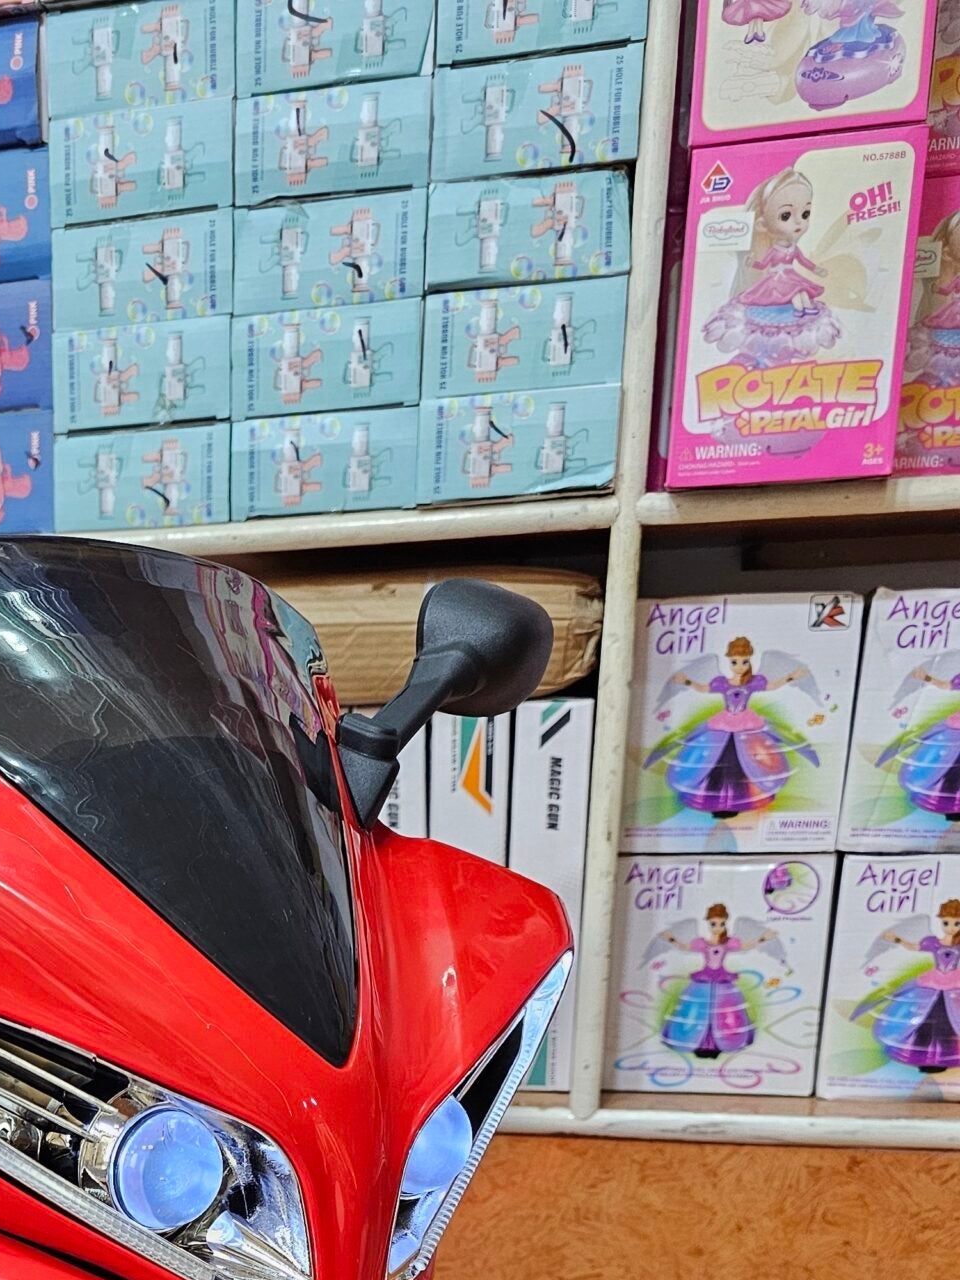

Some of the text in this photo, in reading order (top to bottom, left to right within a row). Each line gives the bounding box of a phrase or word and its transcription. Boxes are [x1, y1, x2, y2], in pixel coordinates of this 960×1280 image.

[455, 5, 463, 21] FUN
[14, 32, 24, 55] PINK
[455, 23, 463, 41] HOLE
[455, 43, 463, 53] 25
[615, 55, 624, 64] 25
[615, 67, 624, 85] HOLE
[614, 88, 622, 102] FUN
[612, 105, 621, 133] BUBBLE
[862, 150, 907, 162] NO.5788B
[27, 168, 36, 194] PINK
[849, 181, 893, 212] OH!
[846, 201, 901, 225] FRESH!
[28, 300, 38, 325] PINK
[695, 360, 883, 423] ROTATE
[750, 409, 827, 436] PETAL
[826, 405, 875, 430] Girl
[30, 431, 40, 455] PINK
[695, 443, 762, 460] WARNING:
[863, 443, 884, 458] 3+
[861, 457, 884, 466] AGES
[894, 455, 944, 470] ARNING:
[646, 598, 728, 633] Angel
[887, 596, 960, 629] Ange
[656, 627, 706, 655] Girl
[896, 622, 951, 649] Girl
[546, 756, 562, 830] MAGIC GUN
[625, 862, 704, 891] Angel
[856, 862, 941, 893] Angel
[634, 886, 683, 911] Girl
[866, 888, 918, 913] Girl
